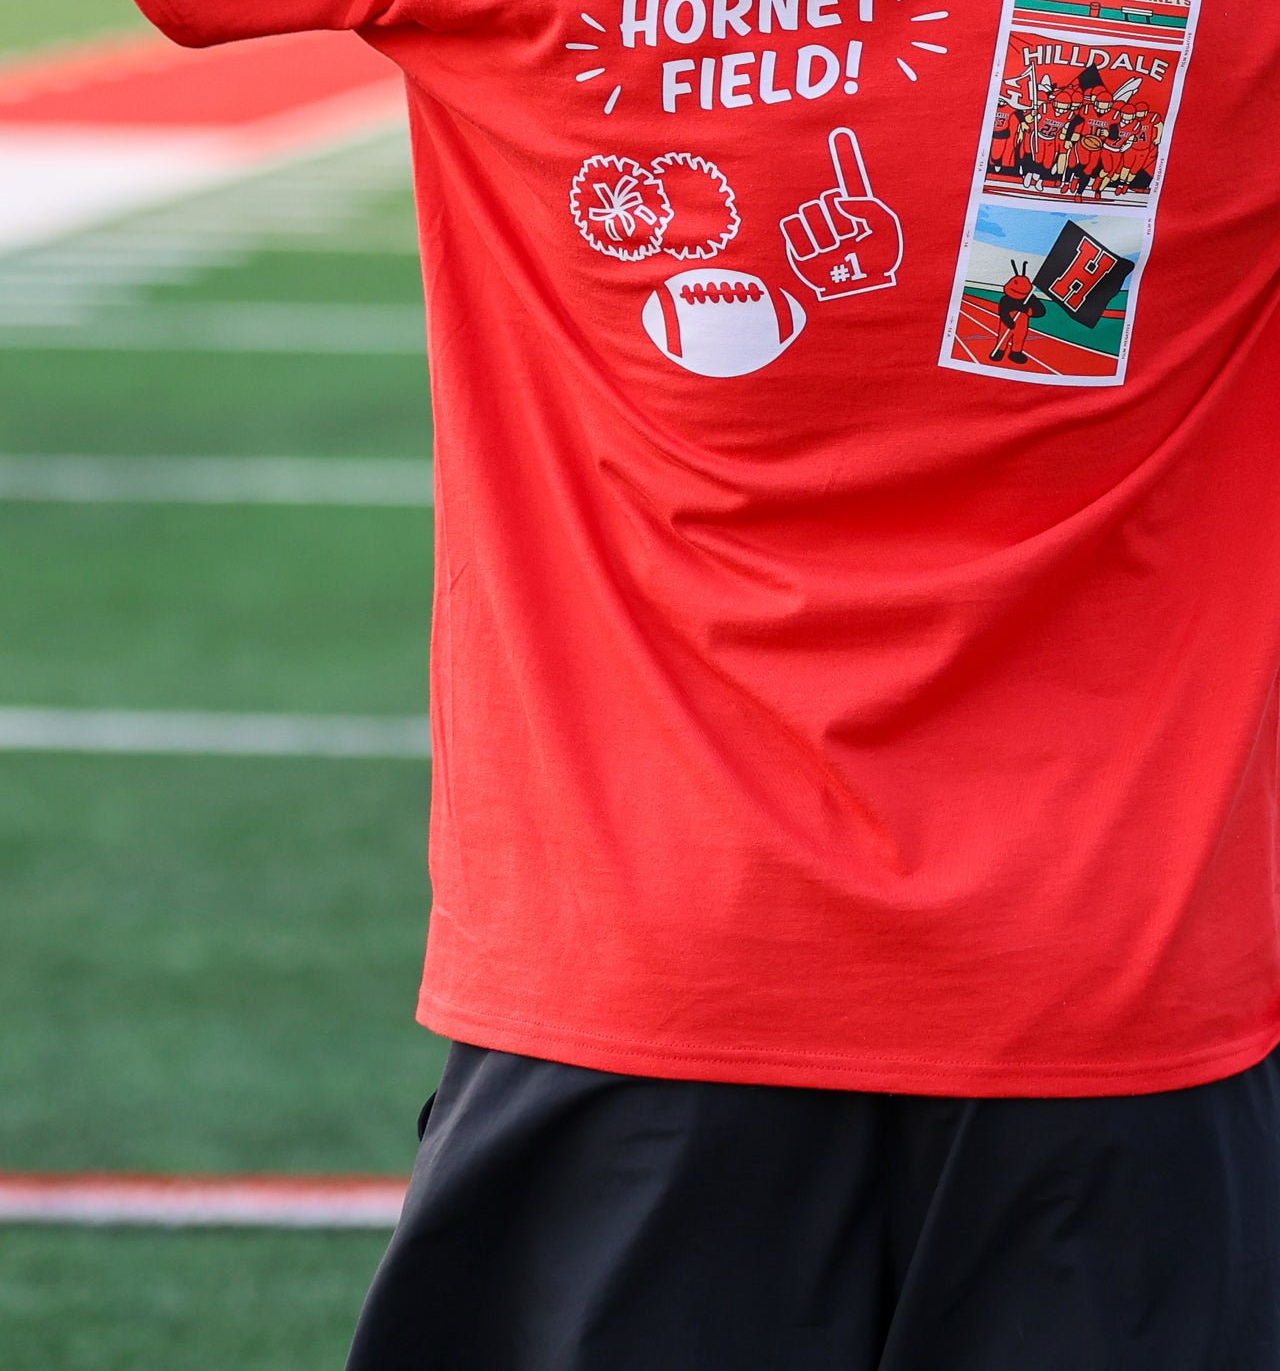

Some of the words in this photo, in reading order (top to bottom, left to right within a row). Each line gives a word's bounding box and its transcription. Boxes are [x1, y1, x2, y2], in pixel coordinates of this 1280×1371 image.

[1183, 32, 1193, 57] NEGATIVE
[662, 40, 864, 114] FIELD!
[1023, 44, 1169, 82] HILLDALE
[1155, 158, 1165, 182] NEGATIVE
[830, 252, 868, 284] #1
[1048, 235, 1118, 313] H
[1122, 323, 1131, 349] NEGATIVE
